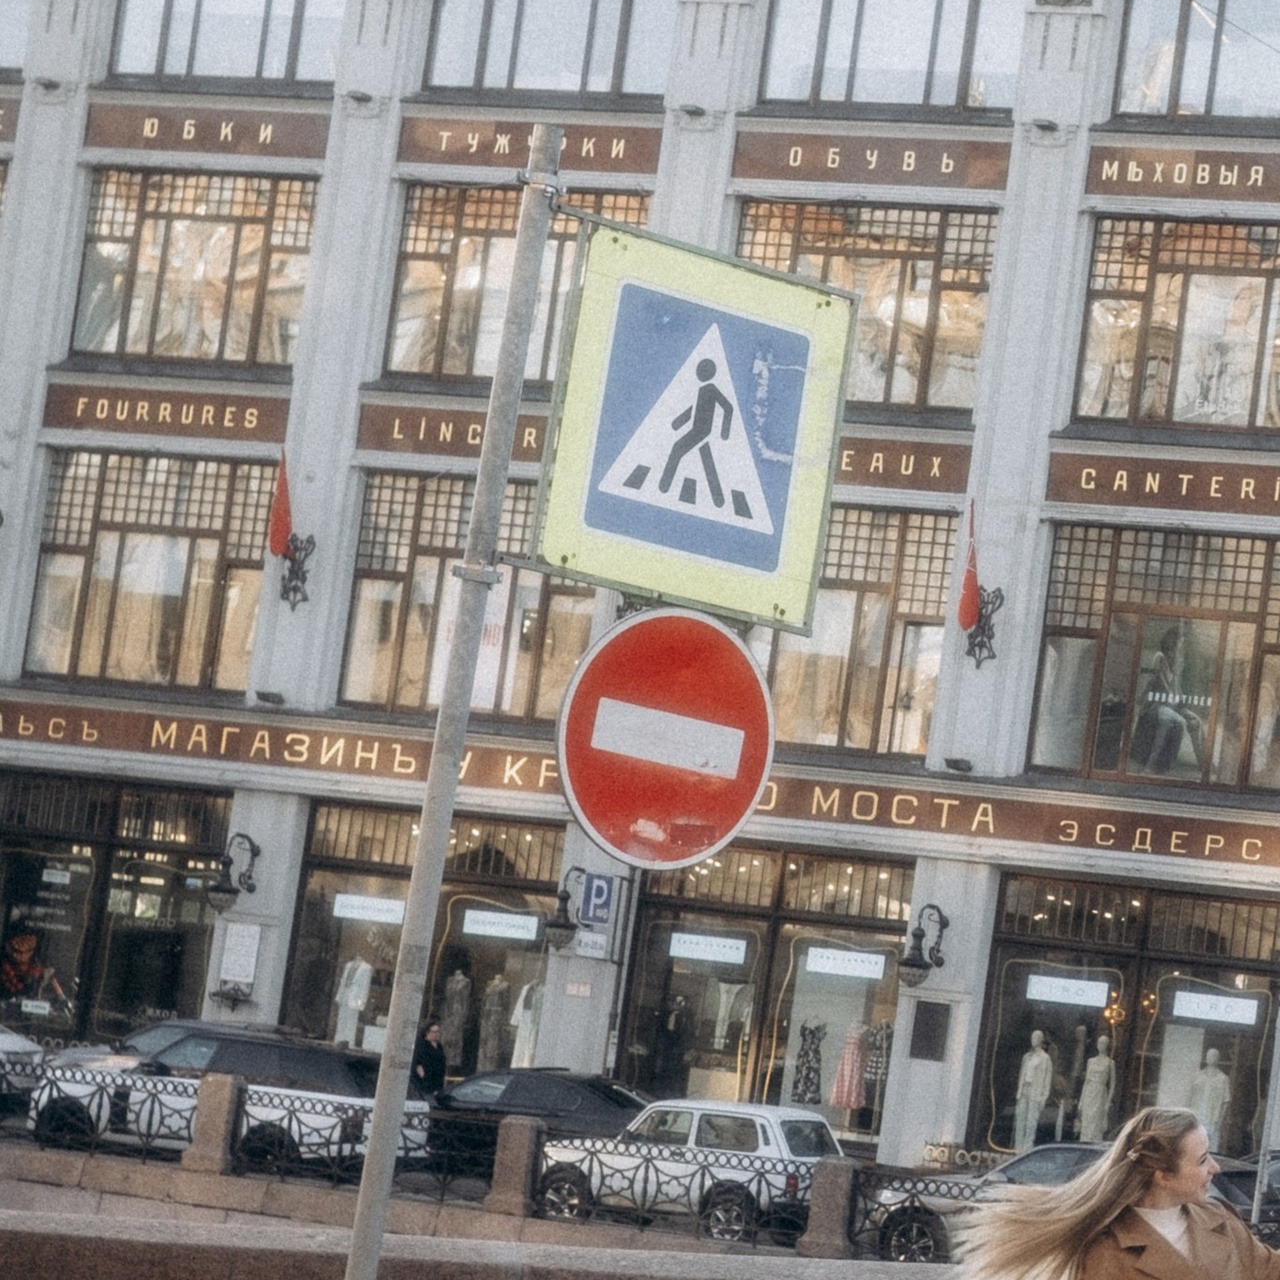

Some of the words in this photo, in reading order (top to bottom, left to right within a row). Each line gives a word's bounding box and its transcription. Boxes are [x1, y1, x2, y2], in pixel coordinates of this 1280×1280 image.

[142, 117, 274, 144] ЮБКИ
[789, 146, 955, 174] ОБУВЬ
[76, 396, 259, 429] FOURRURES
[393, 417, 560, 450] LINGRI
[151, 719, 416, 775] МАГАЗИНЪ
[811, 785, 995, 834] МОСТА
